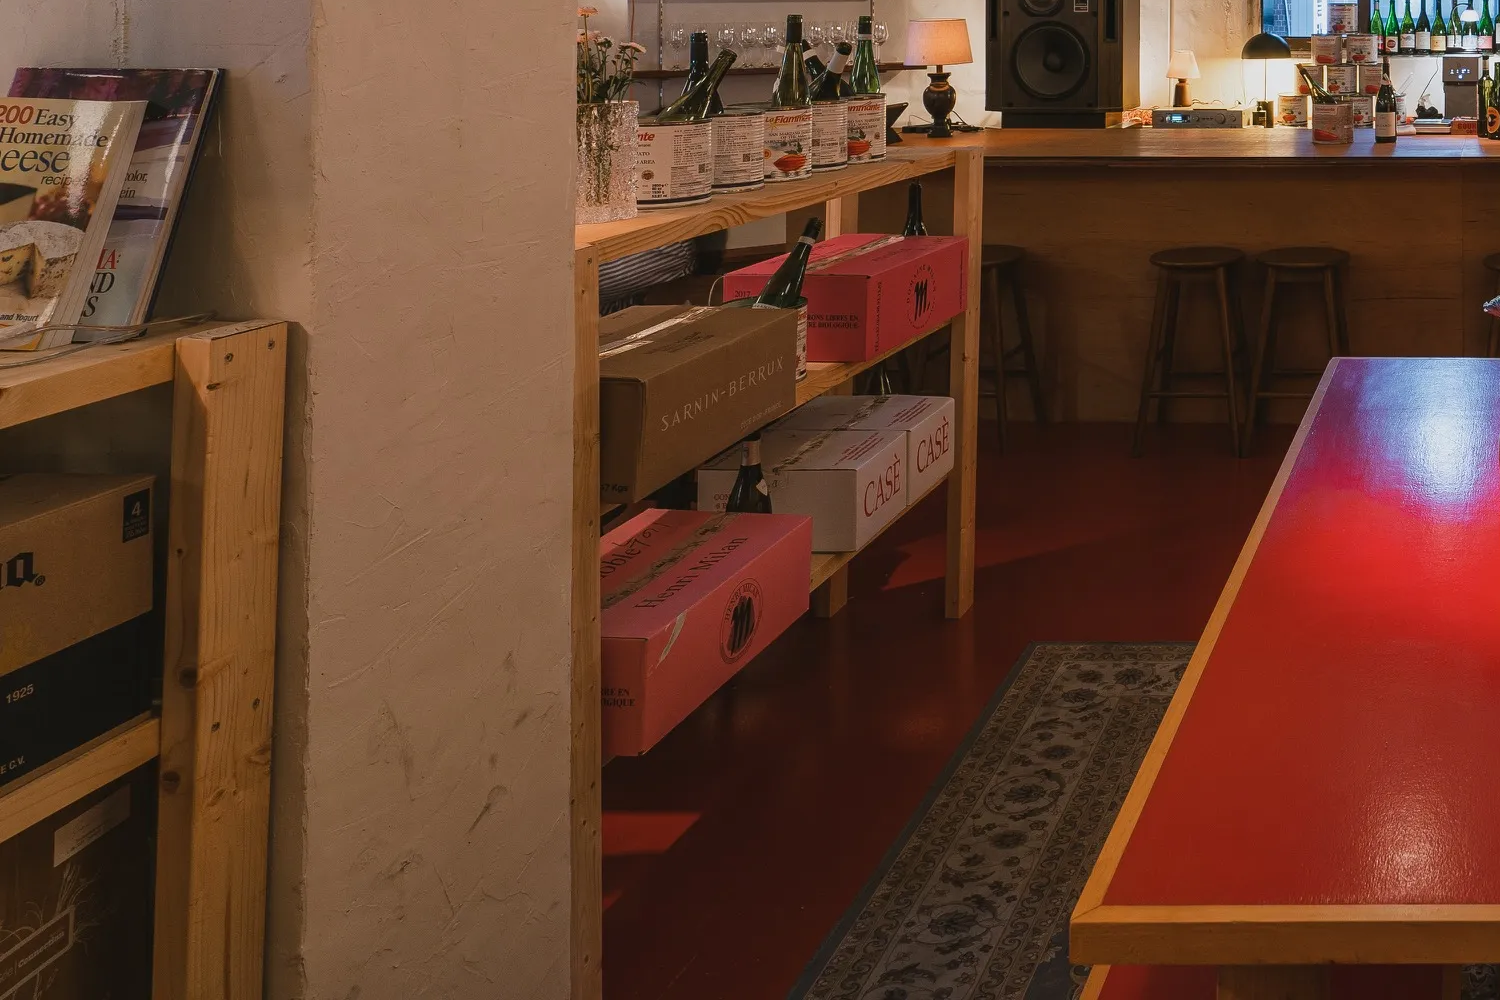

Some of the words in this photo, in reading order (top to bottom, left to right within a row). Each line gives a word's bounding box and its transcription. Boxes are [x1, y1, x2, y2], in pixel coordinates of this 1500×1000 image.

[0, 105, 34, 124] 200
[34, 108, 79, 131] Easy
[0, 150, 70, 173] eese
[16, 313, 39, 322] Yogurt
[661, 356, 784, 432] SARNIN-BERRUX
[917, 415, 949, 474] CASÈ
[864, 453, 901, 518] CASÈ
[633, 575, 700, 608] Henri
[689, 537, 749, 571] Milan
[6, 683, 34, 704] 1925
